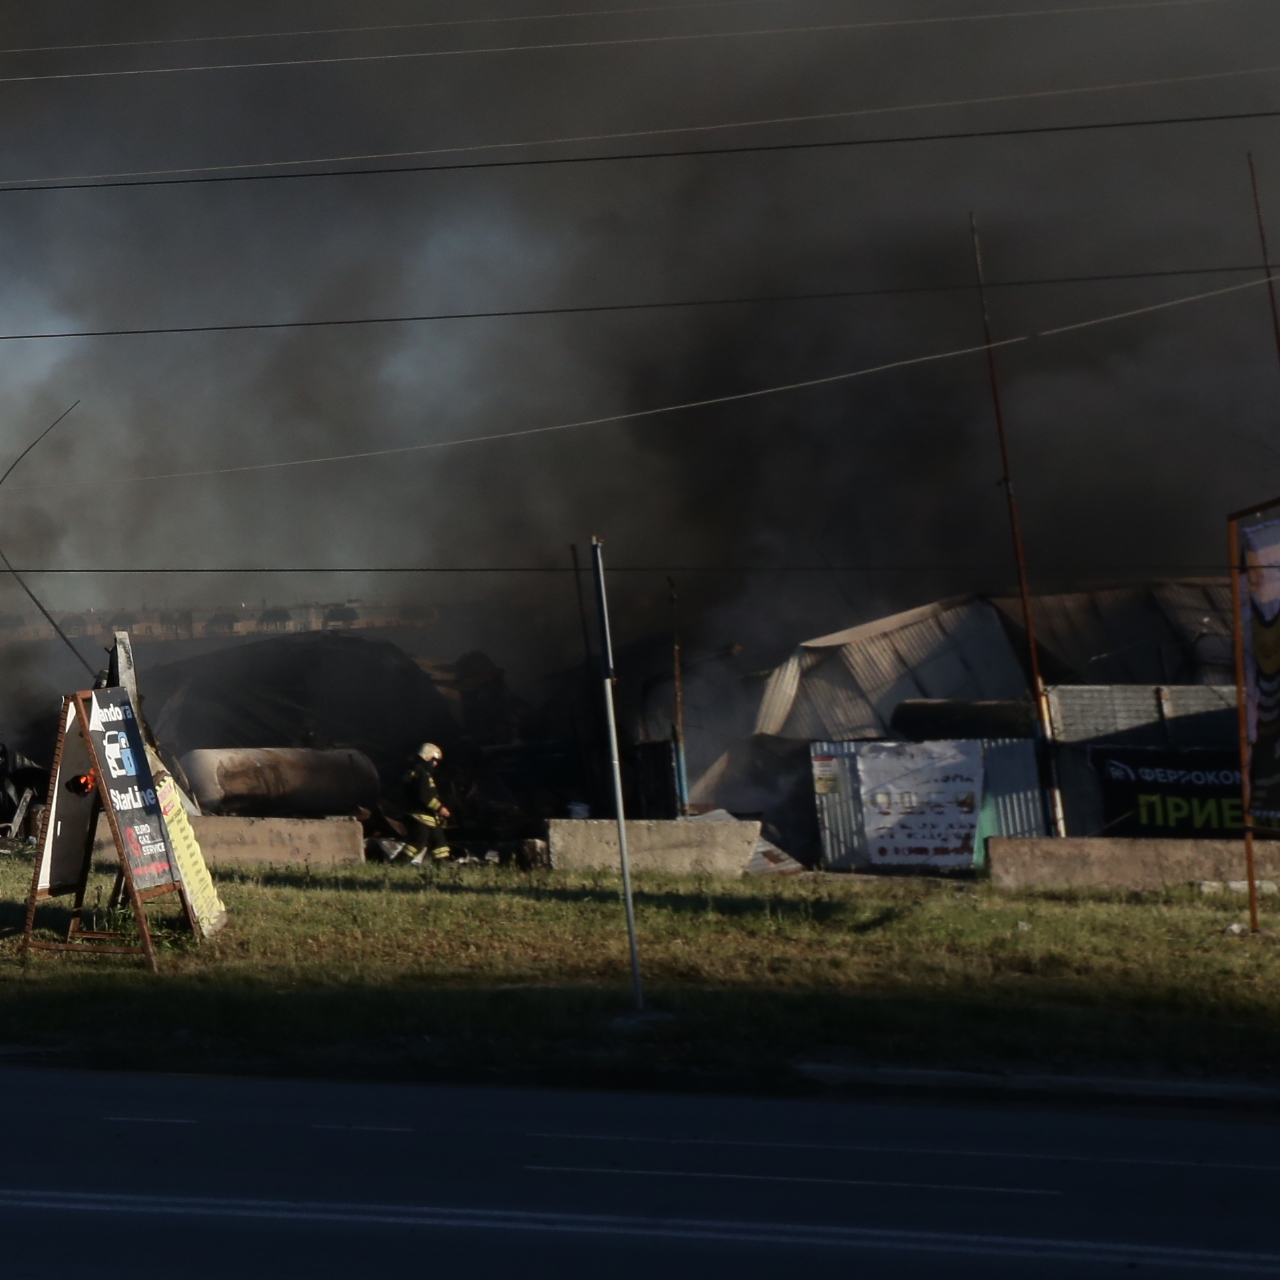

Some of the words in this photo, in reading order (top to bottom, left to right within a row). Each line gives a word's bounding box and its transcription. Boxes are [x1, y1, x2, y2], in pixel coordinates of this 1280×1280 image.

[98, 705, 133, 724] andora
[110, 787, 157, 812] StarLine
[141, 841, 166, 856] SERVICE
